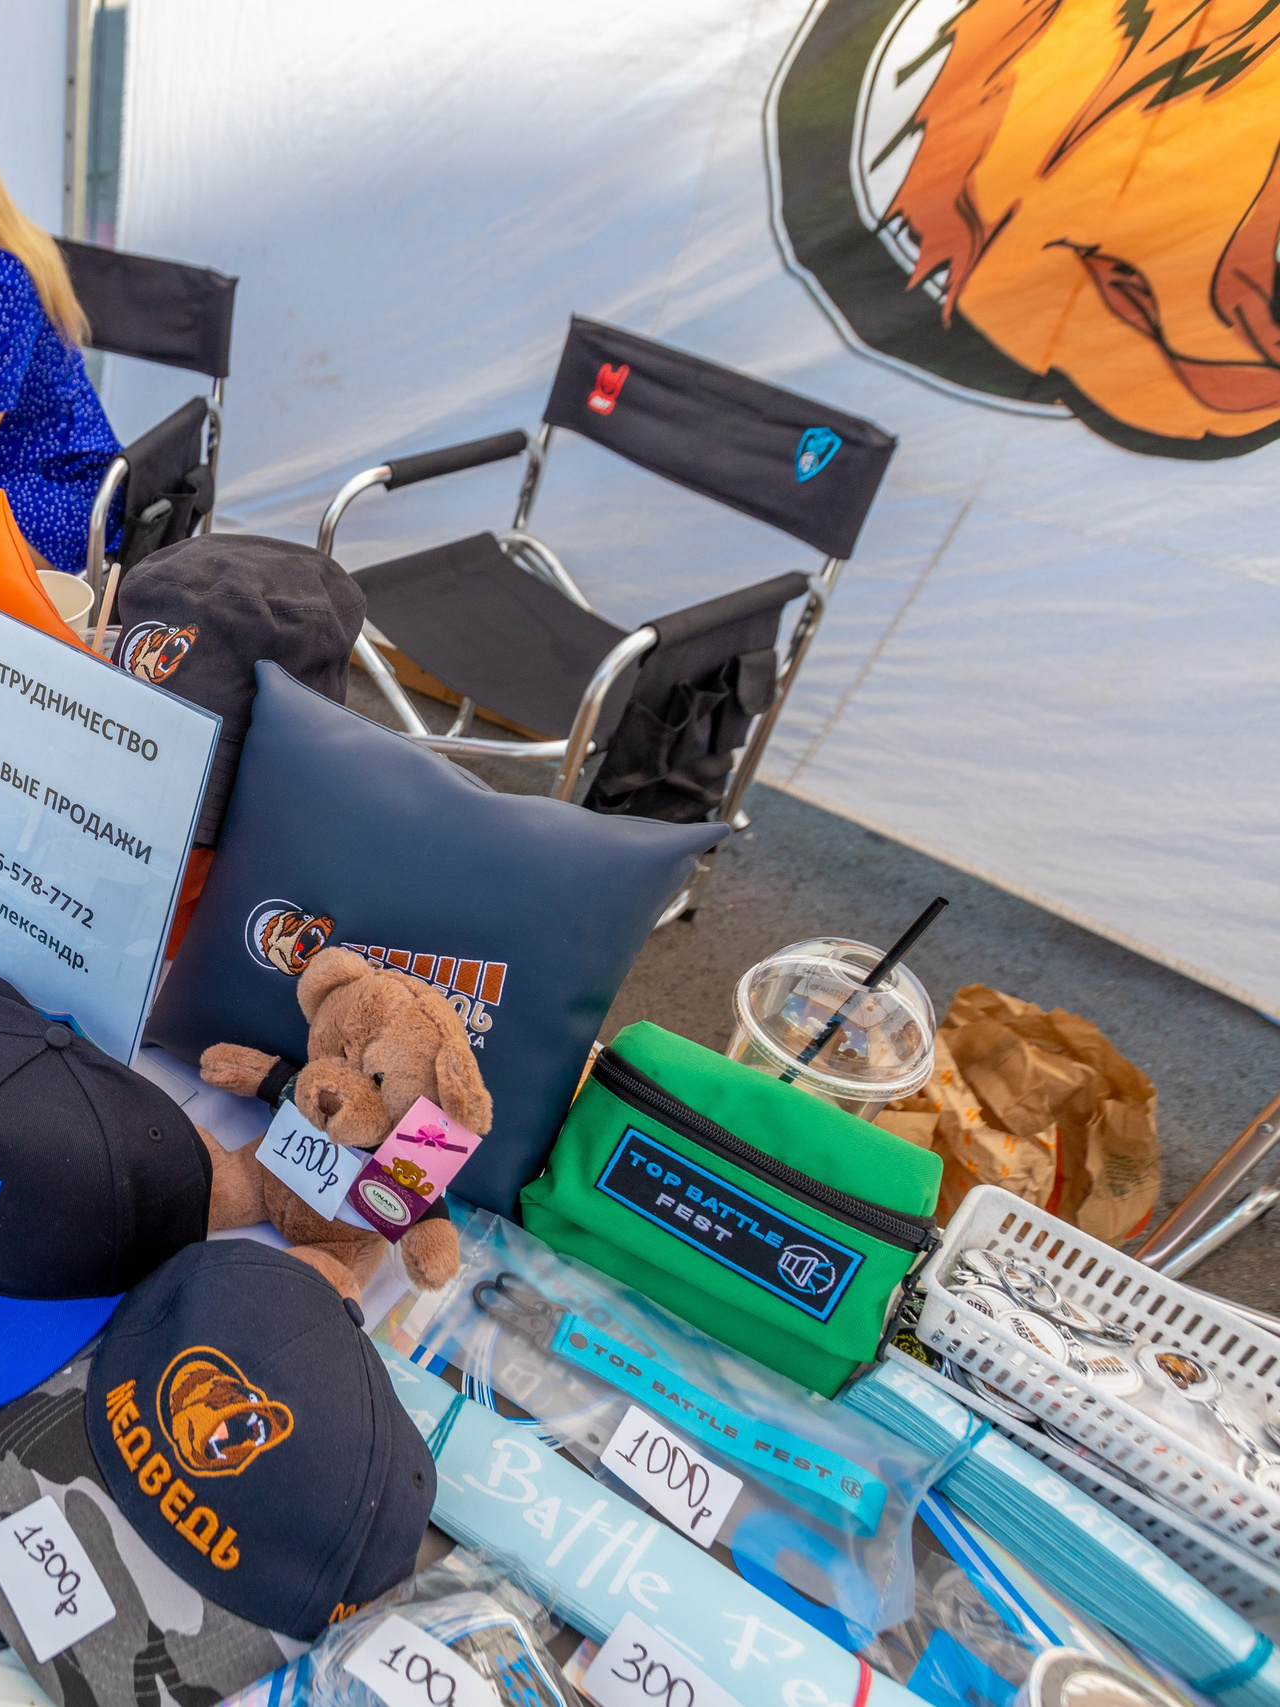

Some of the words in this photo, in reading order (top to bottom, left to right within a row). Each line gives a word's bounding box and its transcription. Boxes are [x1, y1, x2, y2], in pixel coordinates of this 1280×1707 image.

[44, 788, 152, 864] ПРОДАЖИ
[372, 1190, 398, 1211] UNAKY
[629, 1150, 682, 1187] TOP
[685, 1184, 784, 1249] BATTLE
[655, 1192, 733, 1242] FEST
[593, 1343, 642, 1377] TOP
[651, 1379, 739, 1440] BATTLE
[752, 1440, 833, 1480] FEST
[107, 1378, 241, 1571] МЕДВЕДЬ
[615, 1430, 711, 1529] 1000р
